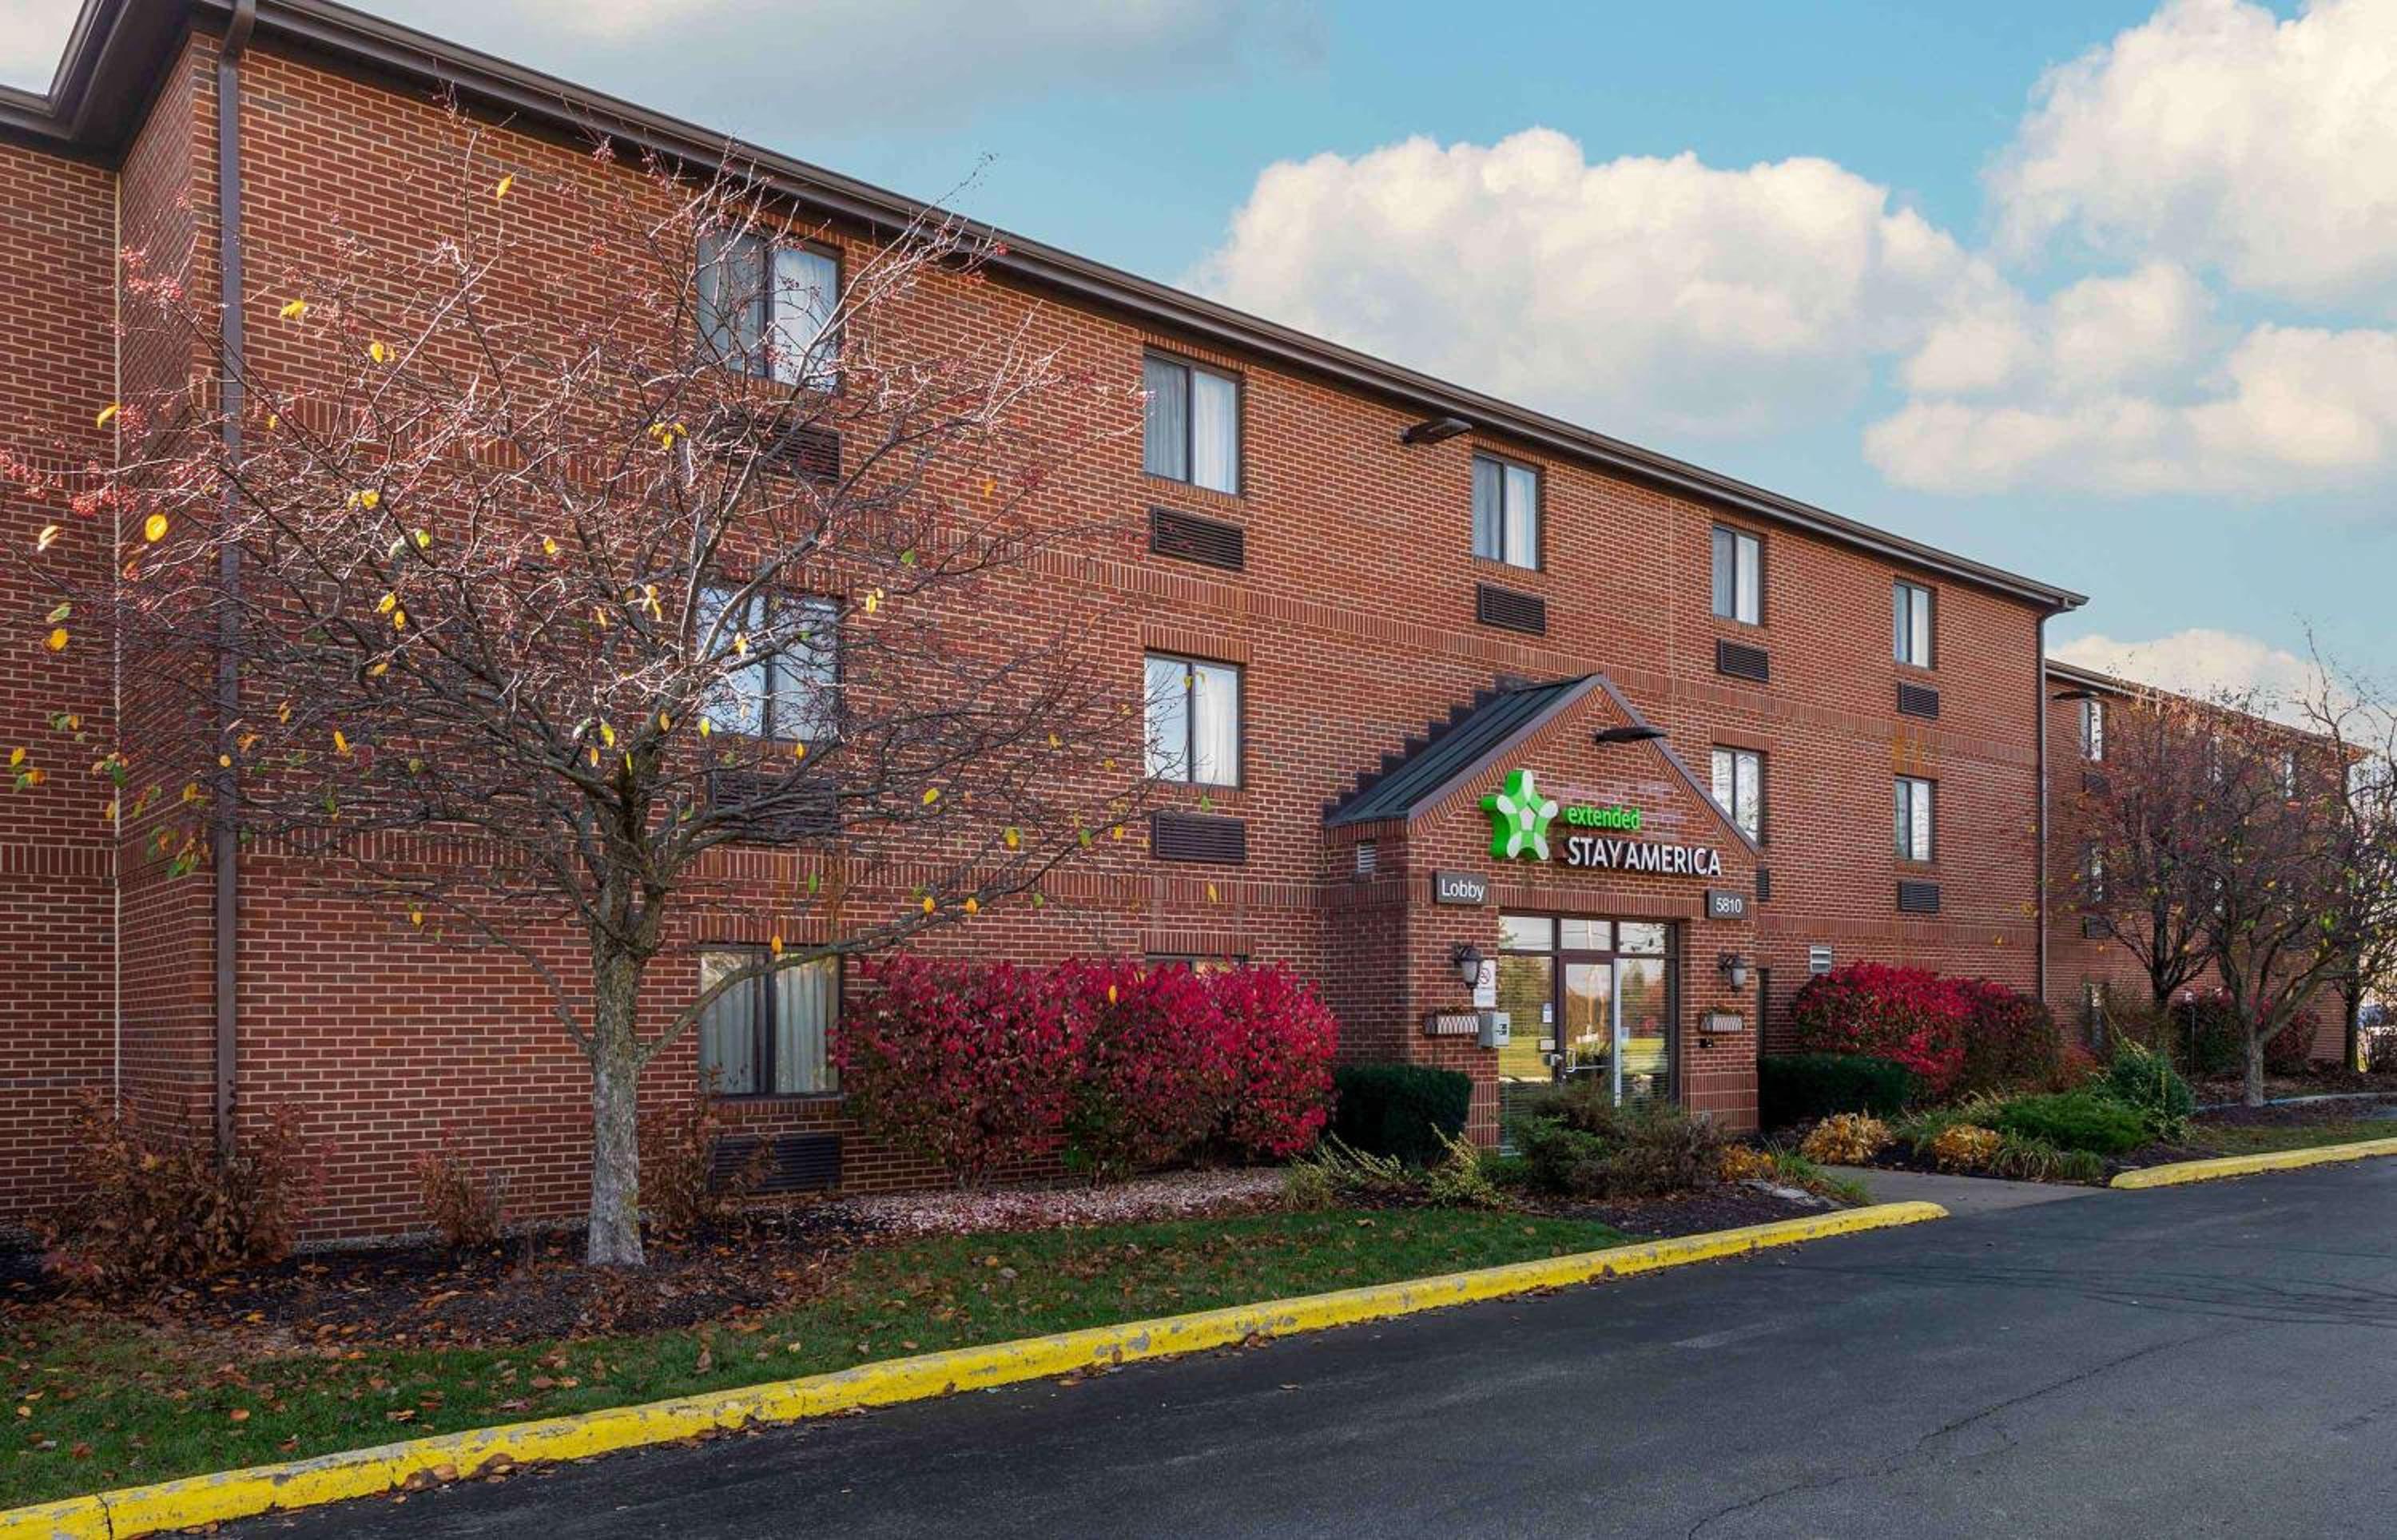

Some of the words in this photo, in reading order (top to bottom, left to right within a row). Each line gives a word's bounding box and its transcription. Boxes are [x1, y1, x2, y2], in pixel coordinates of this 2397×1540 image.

[1567, 805, 1640, 829] extended
[1568, 836, 1622, 868] STAY
[1624, 843, 1722, 876] AMERICA
[1441, 878, 1485, 902] Lobby
[1715, 897, 1743, 913] 5810
